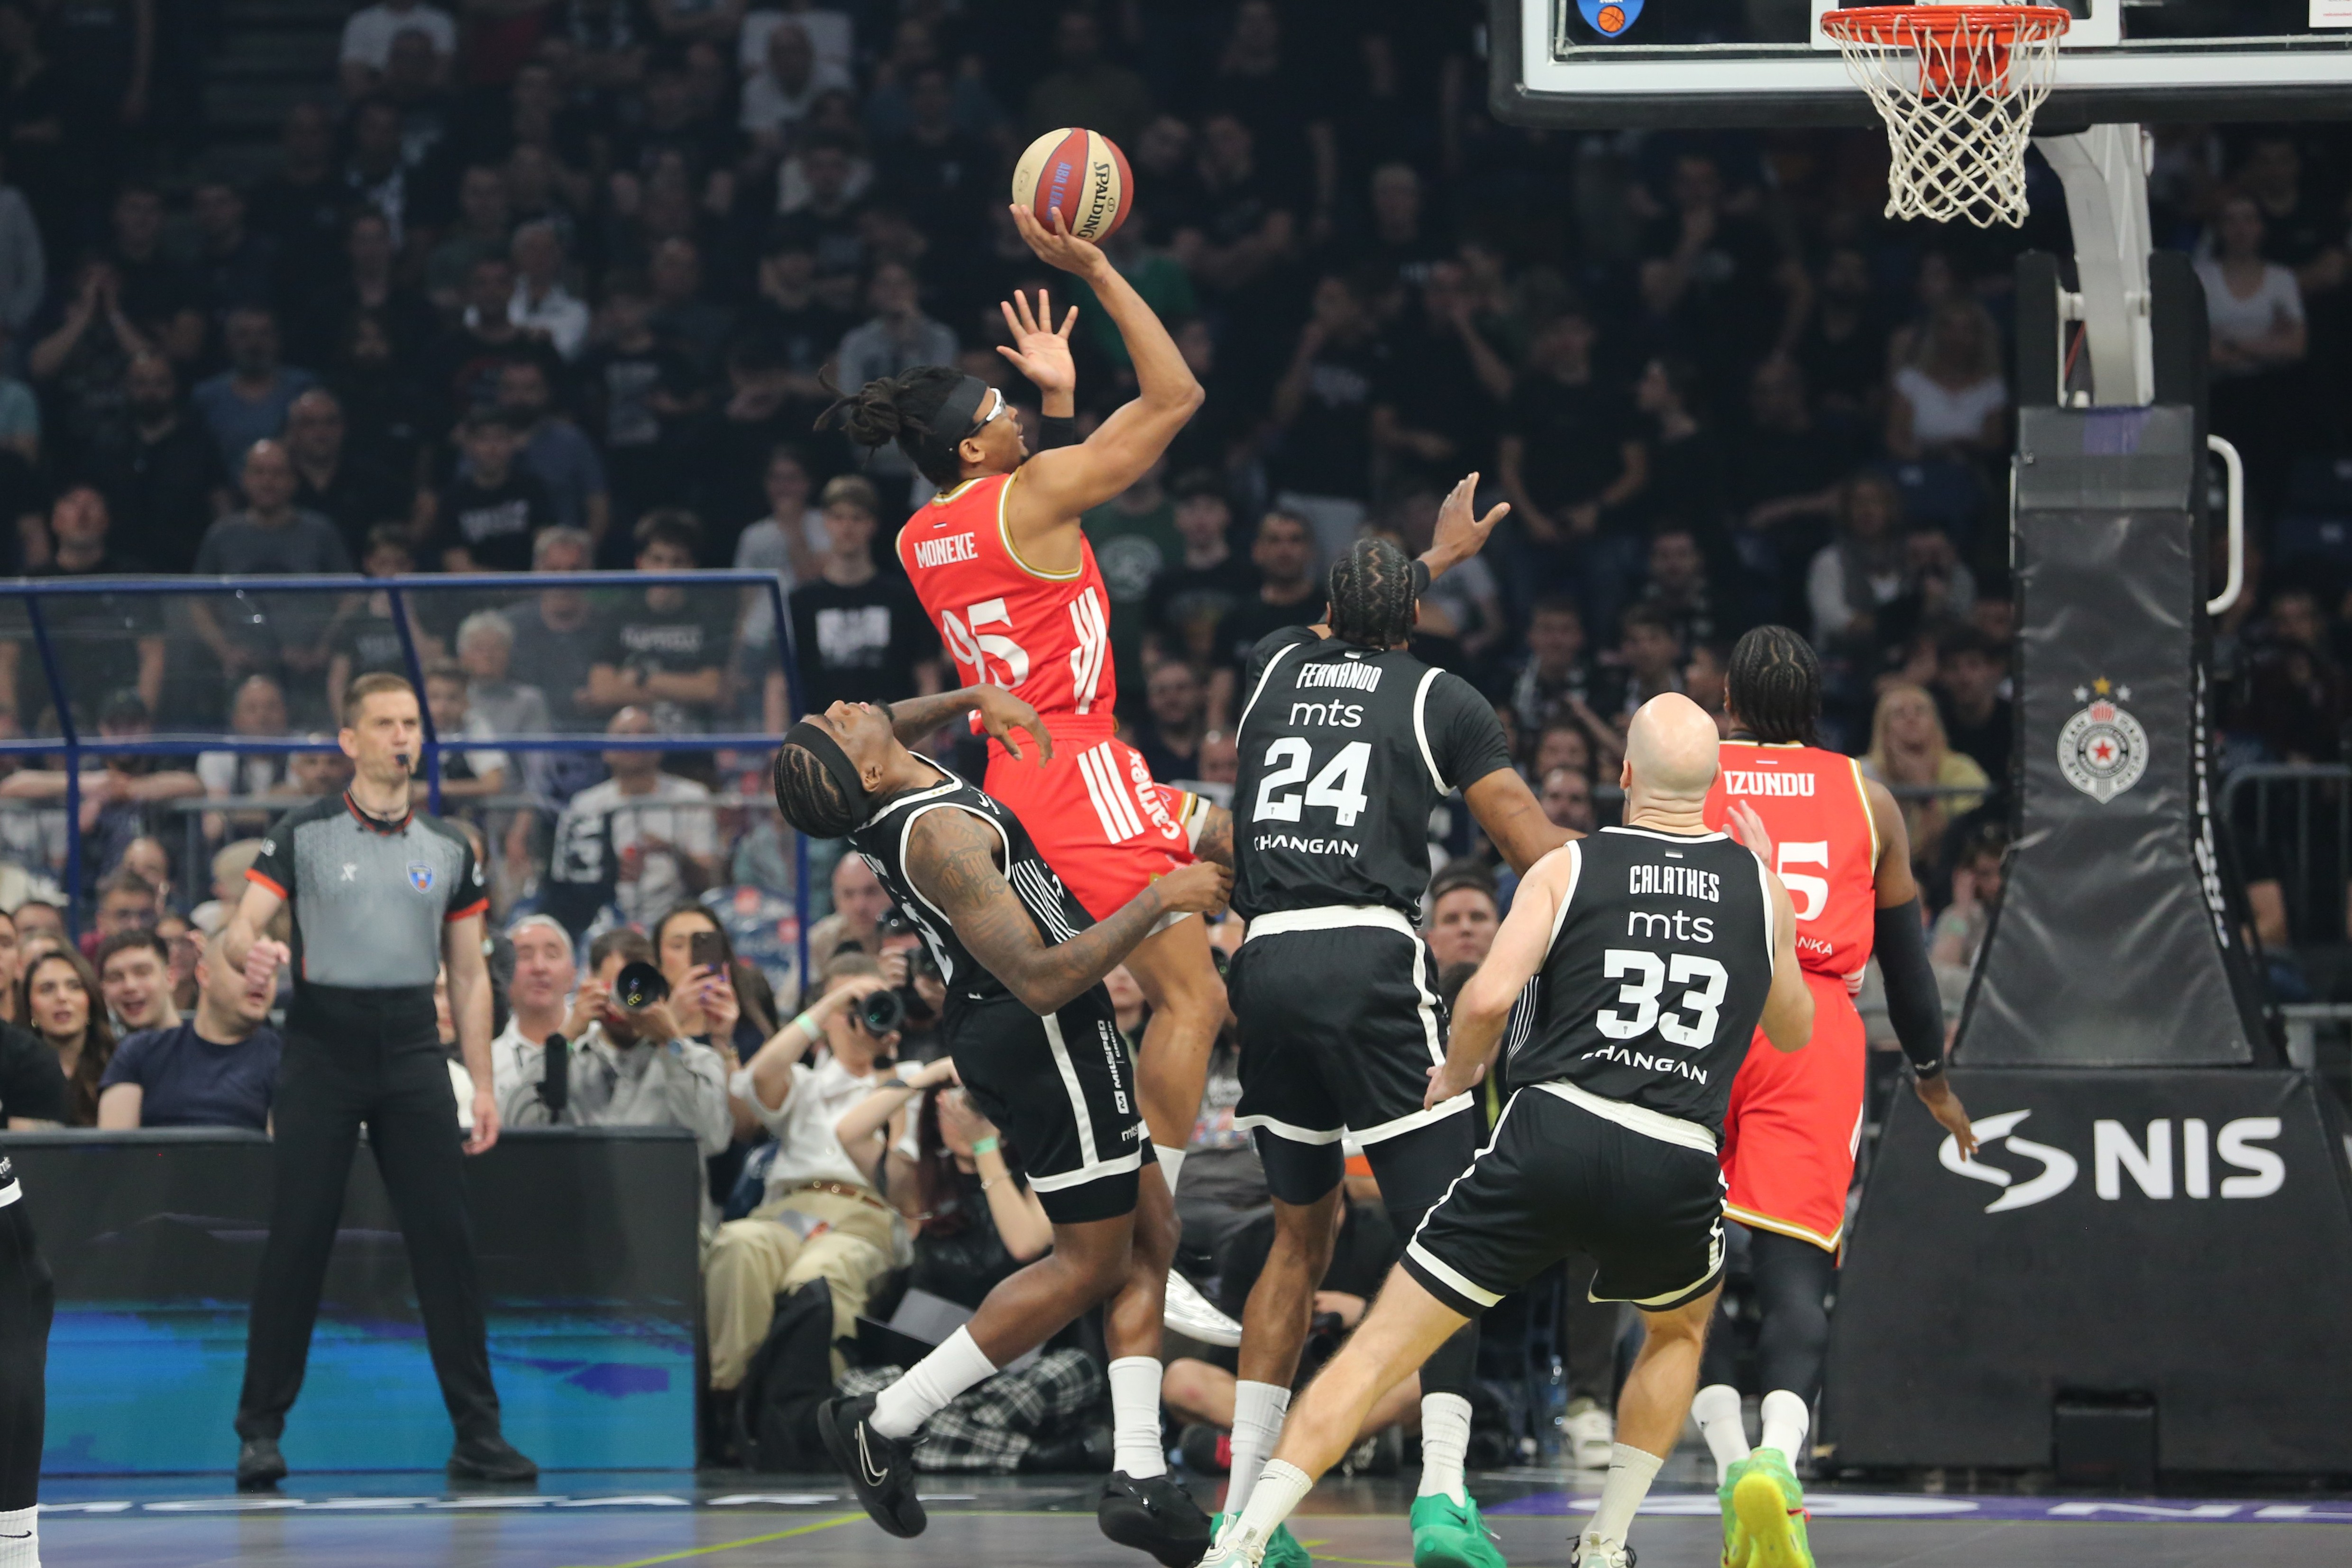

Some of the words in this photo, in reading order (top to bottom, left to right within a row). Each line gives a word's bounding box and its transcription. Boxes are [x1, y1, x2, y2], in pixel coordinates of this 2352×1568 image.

[1054, 162, 1072, 184] ABA
[1078, 162, 1109, 238] SPALDING
[914, 532, 979, 569] MONEKE
[942, 597, 1029, 691] 95
[1295, 662, 1383, 693] FERNANDO
[1289, 698, 1364, 728] mts
[1127, 750, 1181, 840] Carnex
[1252, 737, 1372, 827] 24
[1723, 770, 1815, 797] IZUNDU
[1629, 865, 1720, 903] CALATHES
[1627, 910, 1714, 944] mts
[1795, 935, 1833, 956] NKA
[1595, 949, 1729, 1050] 33
[1098, 1020, 1122, 1089] MILSPED
[2094, 1117, 2286, 1201] NIS
